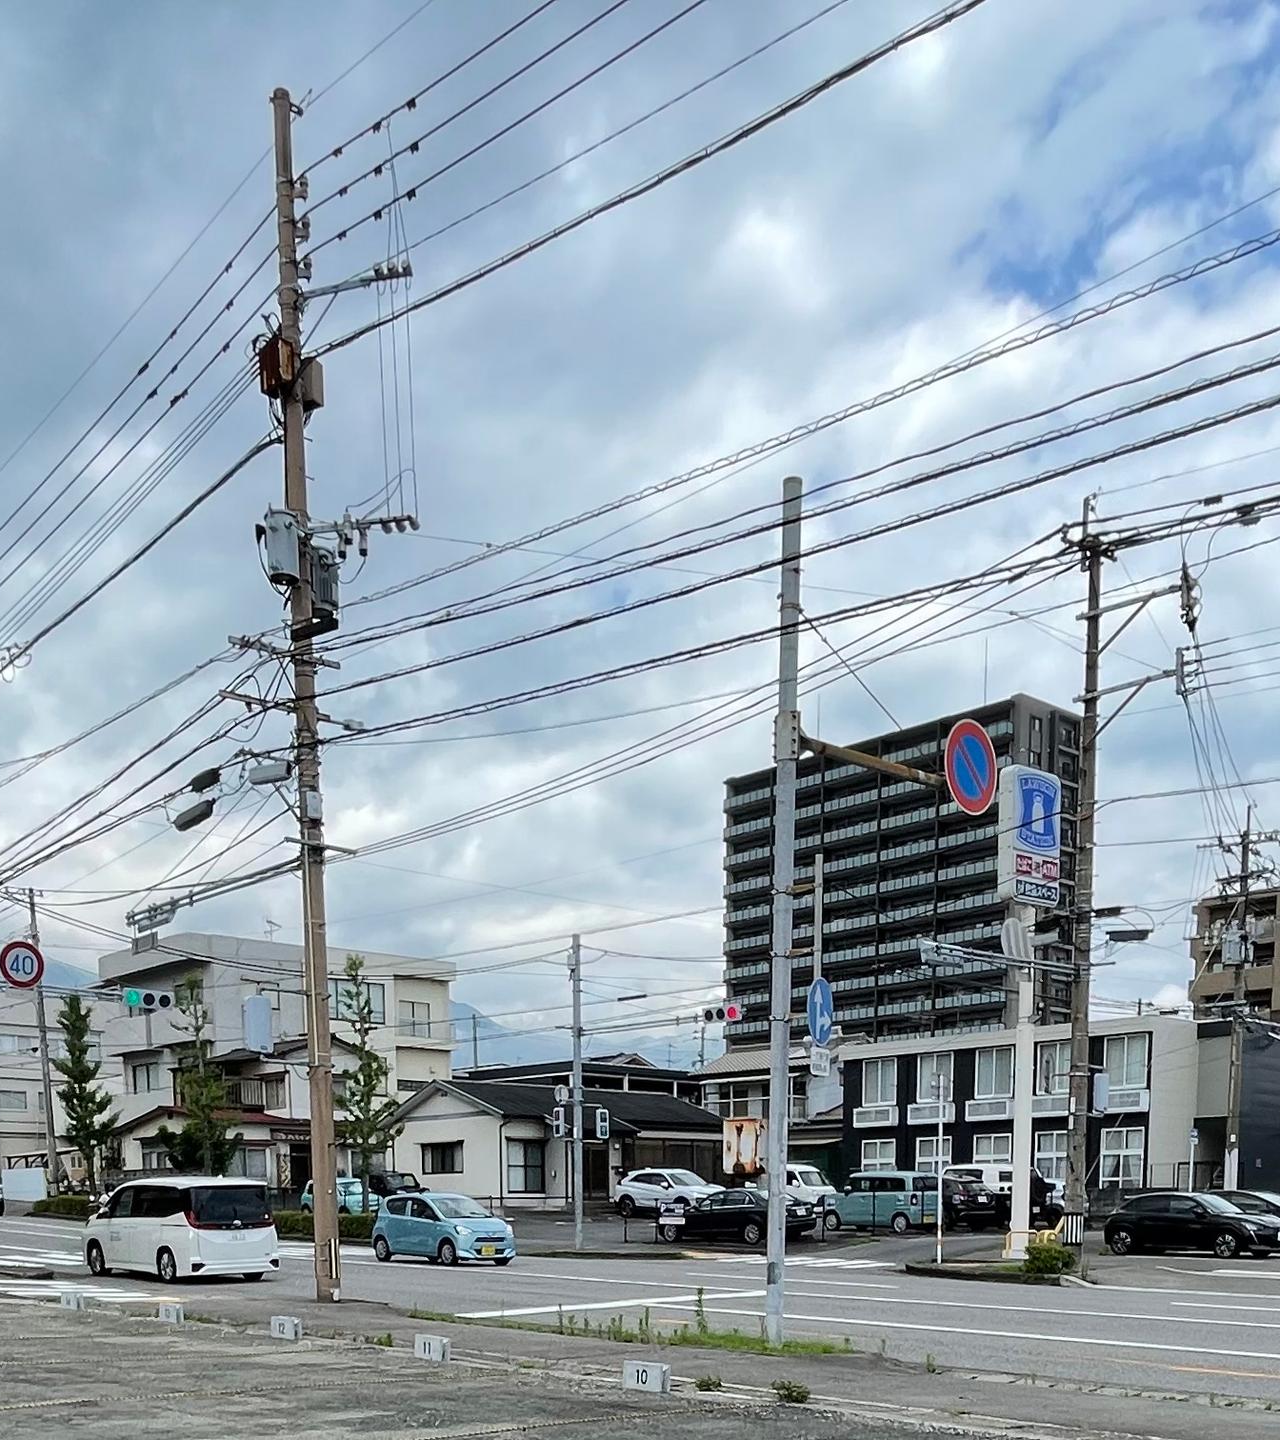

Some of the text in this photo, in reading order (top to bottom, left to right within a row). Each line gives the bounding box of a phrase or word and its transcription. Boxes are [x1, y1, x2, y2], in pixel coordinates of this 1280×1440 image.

[10, 954, 34, 975] 40
[278, 1322, 286, 1335] 12
[423, 1341, 431, 1355] 11
[636, 1369, 648, 1385] 10
